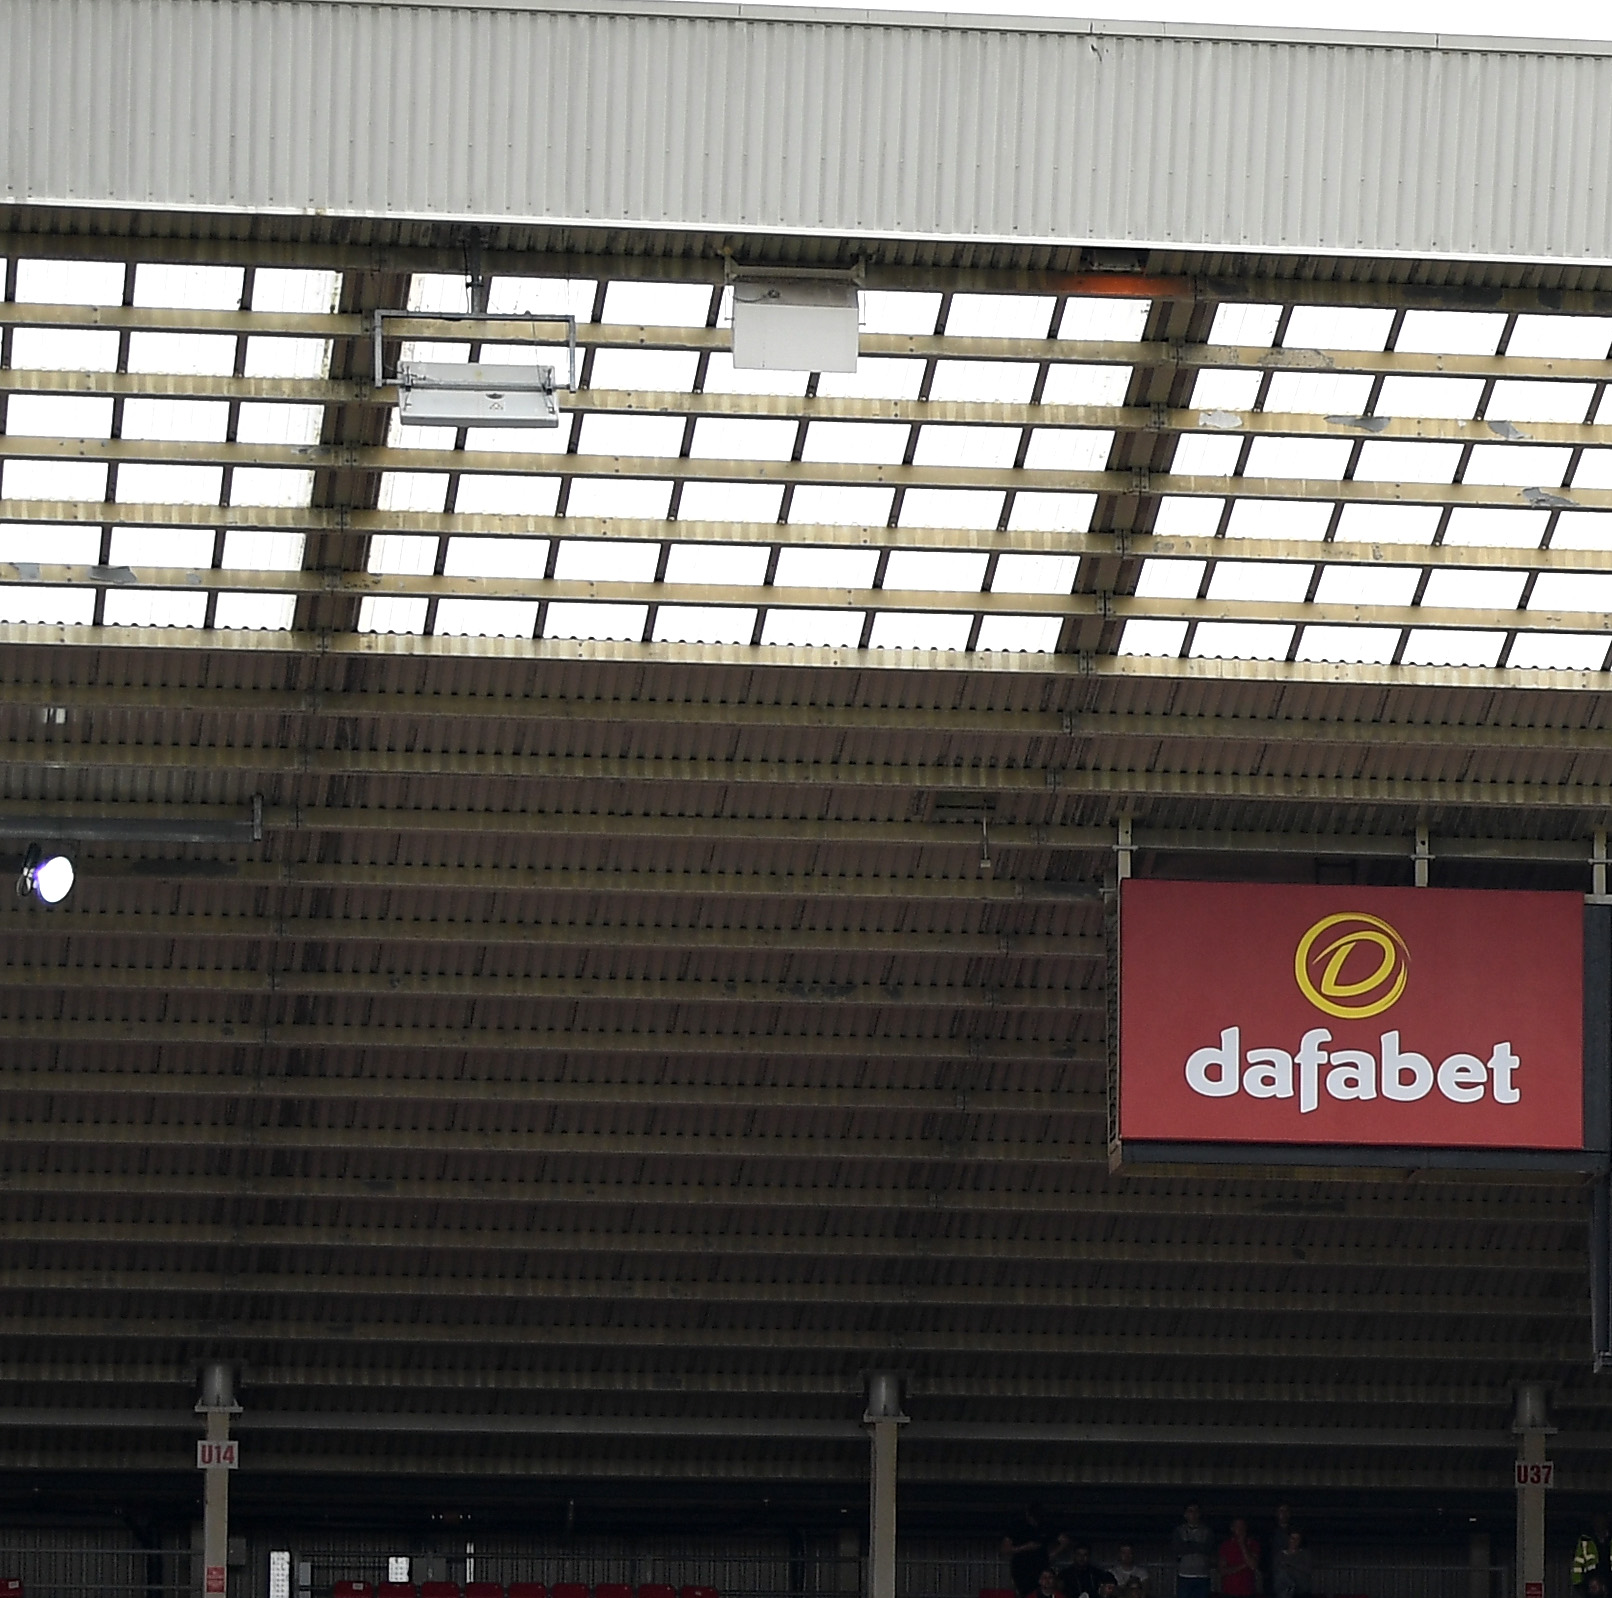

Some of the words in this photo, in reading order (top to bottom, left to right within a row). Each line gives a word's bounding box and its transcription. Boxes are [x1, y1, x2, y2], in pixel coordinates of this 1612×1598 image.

[1185, 1026, 1521, 1114] dafabet
[200, 1444, 235, 1465] U14
[1516, 1464, 1553, 1485] U37
